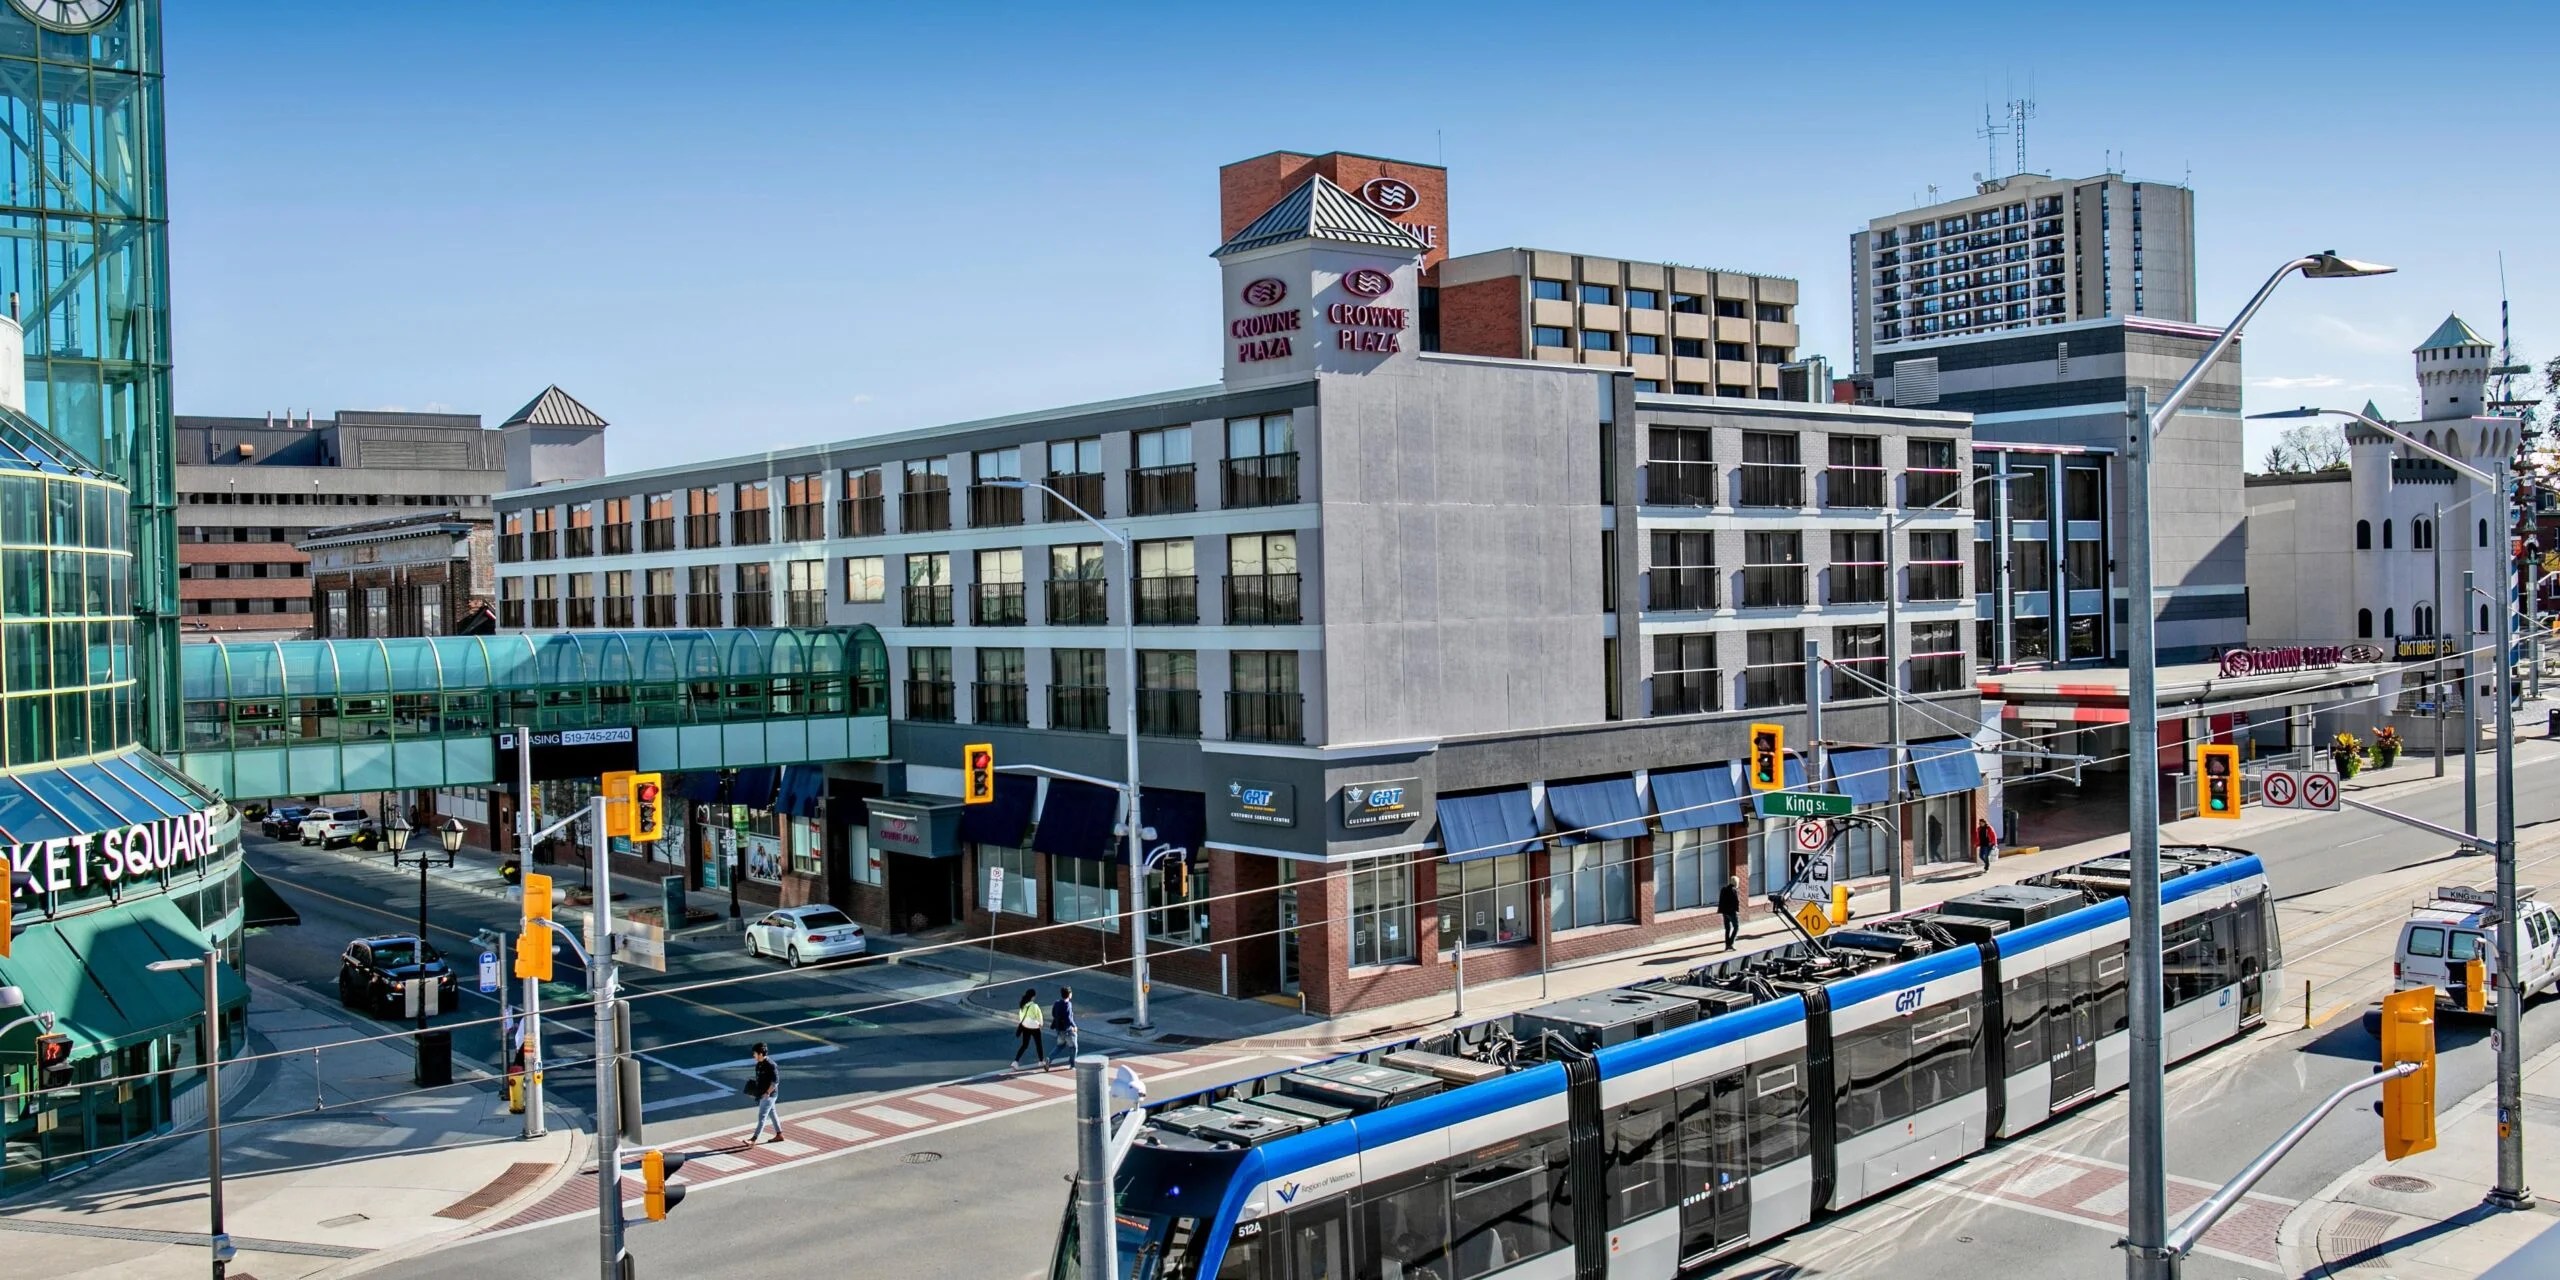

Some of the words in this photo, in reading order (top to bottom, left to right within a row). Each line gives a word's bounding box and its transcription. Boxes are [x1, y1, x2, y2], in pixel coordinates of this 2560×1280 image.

[1231, 309, 1301, 338] CROWNE
[1328, 303, 1409, 329] CROWNE
[1339, 329, 1401, 352] PLAZA
[1238, 337, 1293, 363] PLAZA
[2399, 639, 2456, 657] OKTOBEEST
[515, 734, 560, 745] LASING
[564, 730, 630, 743] 519-745-2740
[1243, 789, 1273, 806] GRT
[1368, 787, 1404, 807] GRT
[1785, 795, 1814, 815] King
[1816, 801, 1829, 811] St.
[1349, 817, 1377, 825] CUSTOMER
[0, 834, 93, 898] KET
[103, 808, 218, 881] SQUARE
[1802, 892, 1820, 900] LANE
[1804, 884, 1819, 892] THIS
[2450, 891, 2470, 900] KING
[1802, 915, 1821, 931] 10
[486, 966, 491, 974] 7
[1895, 986, 1926, 1012] GRT
[1301, 1182, 1321, 1193] Region
[1321, 1178, 1329, 1187] of
[1238, 1222, 1262, 1238] 512A
